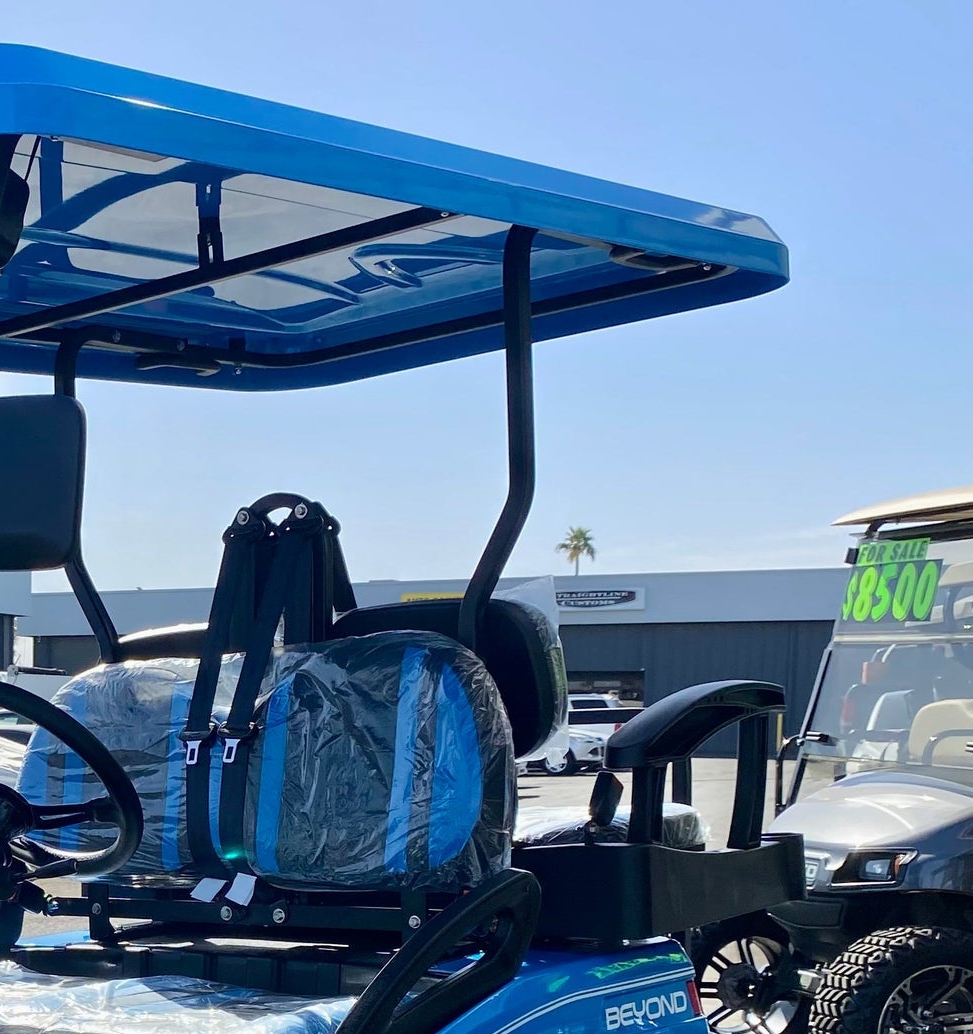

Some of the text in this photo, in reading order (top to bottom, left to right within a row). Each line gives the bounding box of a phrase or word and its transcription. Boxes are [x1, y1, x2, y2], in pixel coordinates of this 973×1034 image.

[858, 540, 929, 564] FOR SALE
[556, 591, 629, 600] TRAIGHTLINE
[561, 599, 616, 607] CUSTOMS
[842, 561, 938, 622] $8500
[605, 991, 687, 1030] BEYOND
